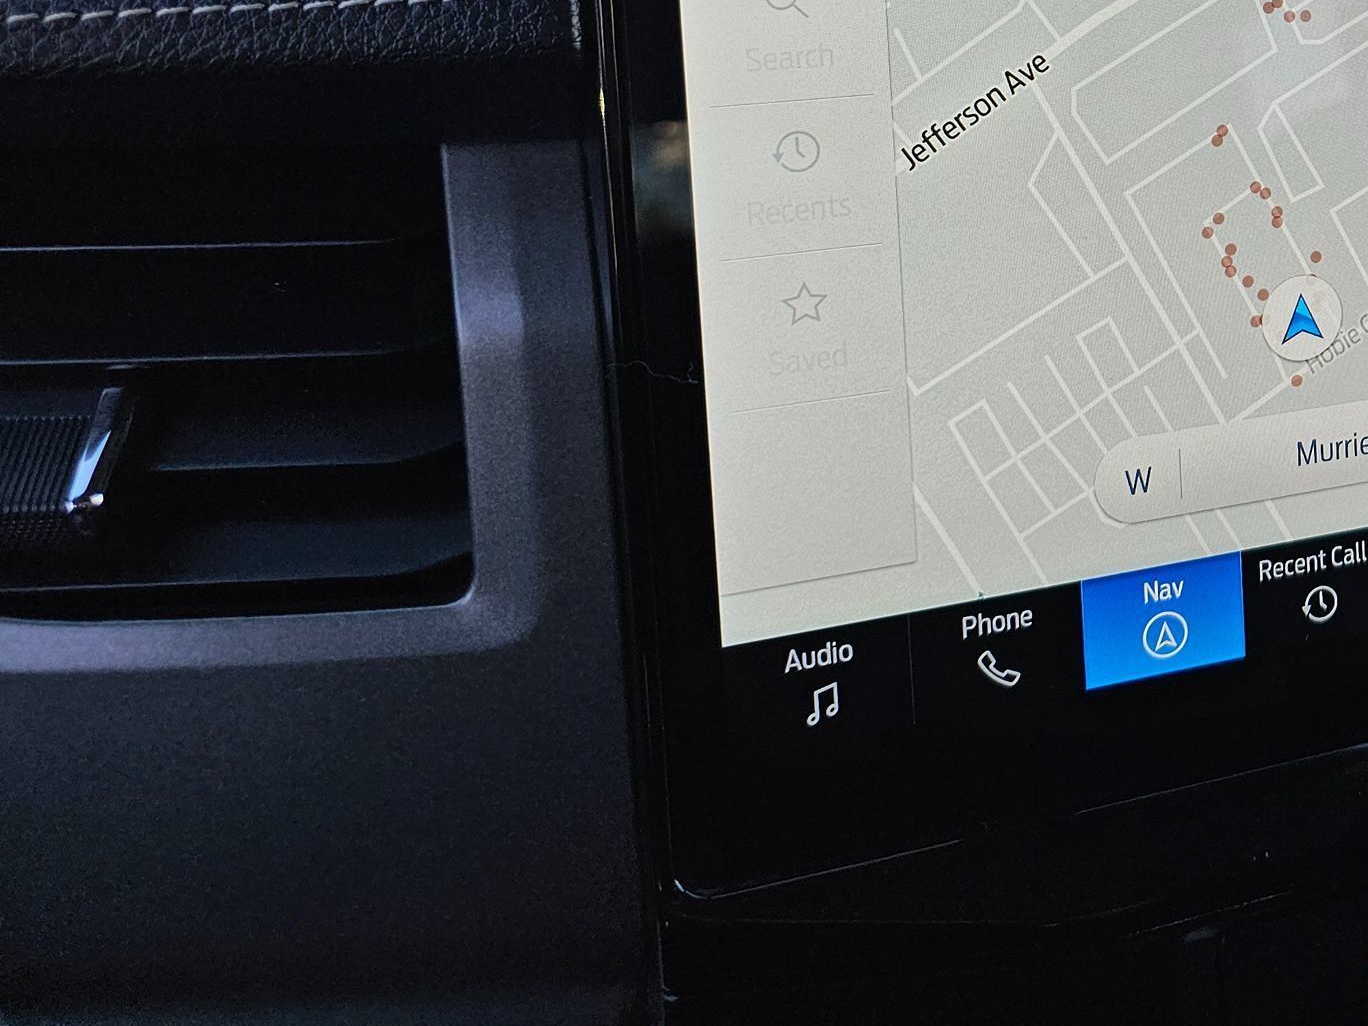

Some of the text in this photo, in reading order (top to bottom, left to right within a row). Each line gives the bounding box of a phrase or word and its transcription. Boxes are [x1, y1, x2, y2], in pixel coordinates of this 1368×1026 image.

[746, 43, 834, 71] Search
[900, 54, 1050, 172] Jefferson Ave
[746, 194, 852, 227] Recents
[768, 342, 848, 374] Saved
[1125, 467, 1152, 495] W
[1259, 549, 1327, 582] Recent
[1143, 577, 1184, 605] Nav
[961, 605, 1034, 640] Phone
[784, 641, 853, 673] Audio
